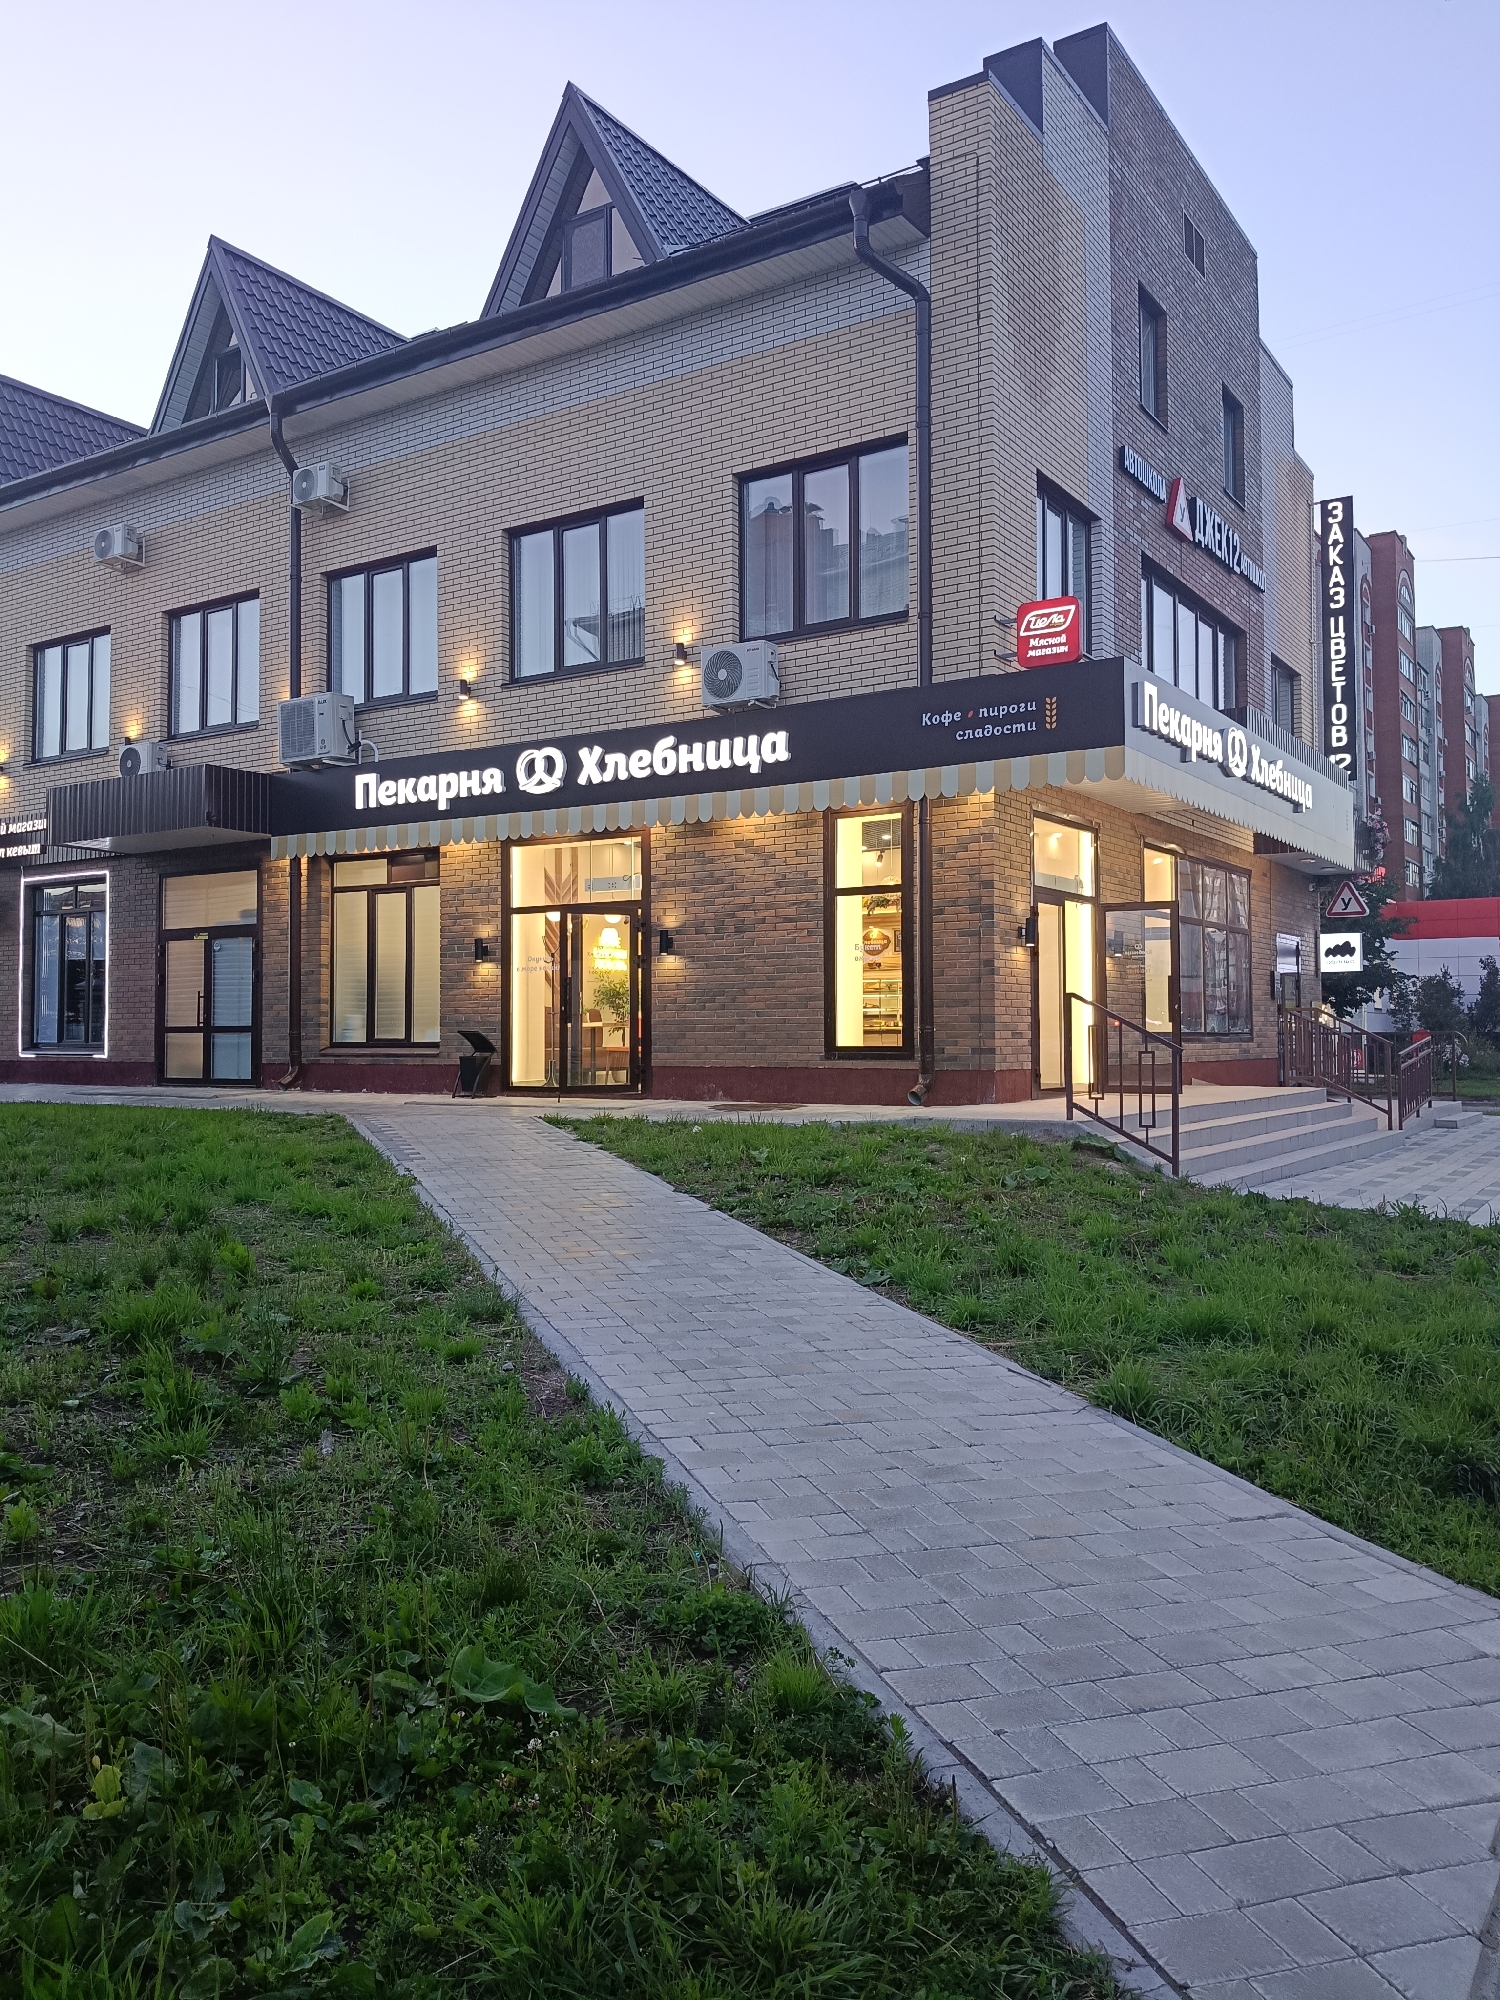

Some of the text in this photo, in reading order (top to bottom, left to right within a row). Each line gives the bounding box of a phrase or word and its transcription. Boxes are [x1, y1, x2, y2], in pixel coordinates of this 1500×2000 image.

[1124, 445, 1167, 503] АВТОШКОЛА
[1327, 501, 1345, 609] ЗАКАЗ
[1027, 645, 1069, 657] магазин
[1029, 633, 1067, 647] Мясной
[1330, 615, 1348, 747] ЦВЕТОВ
[922, 701, 1037, 727] Кофе пироги
[955, 721, 1037, 740] сладости
[1143, 681, 1313, 813] Пекарня Хлебница
[355, 731, 790, 810] Пекарня Хлебница
[1340, 897, 1353, 911] У
